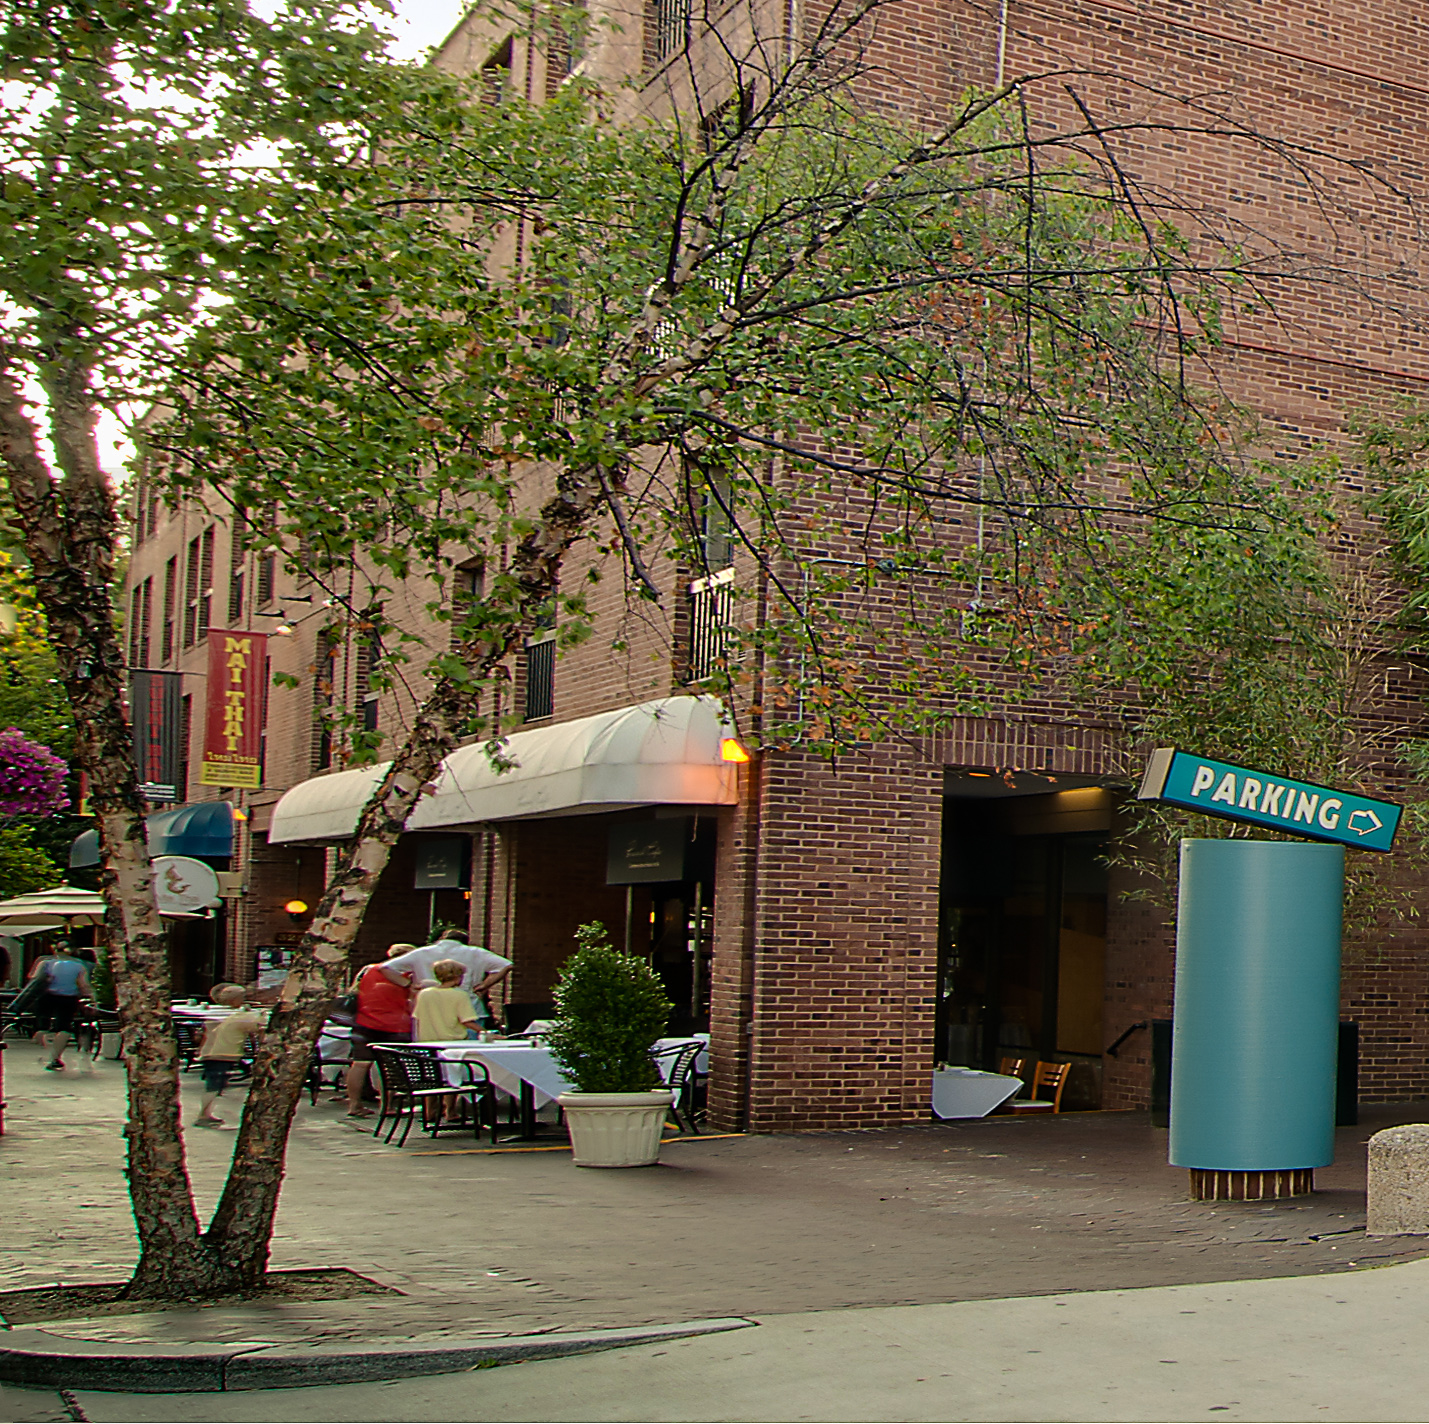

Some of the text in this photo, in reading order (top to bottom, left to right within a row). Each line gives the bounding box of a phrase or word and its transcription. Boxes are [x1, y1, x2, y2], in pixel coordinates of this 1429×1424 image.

[224, 637, 251, 683] MAI
[222, 691, 245, 751] THAI
[1190, 765, 1343, 830] PARKING
